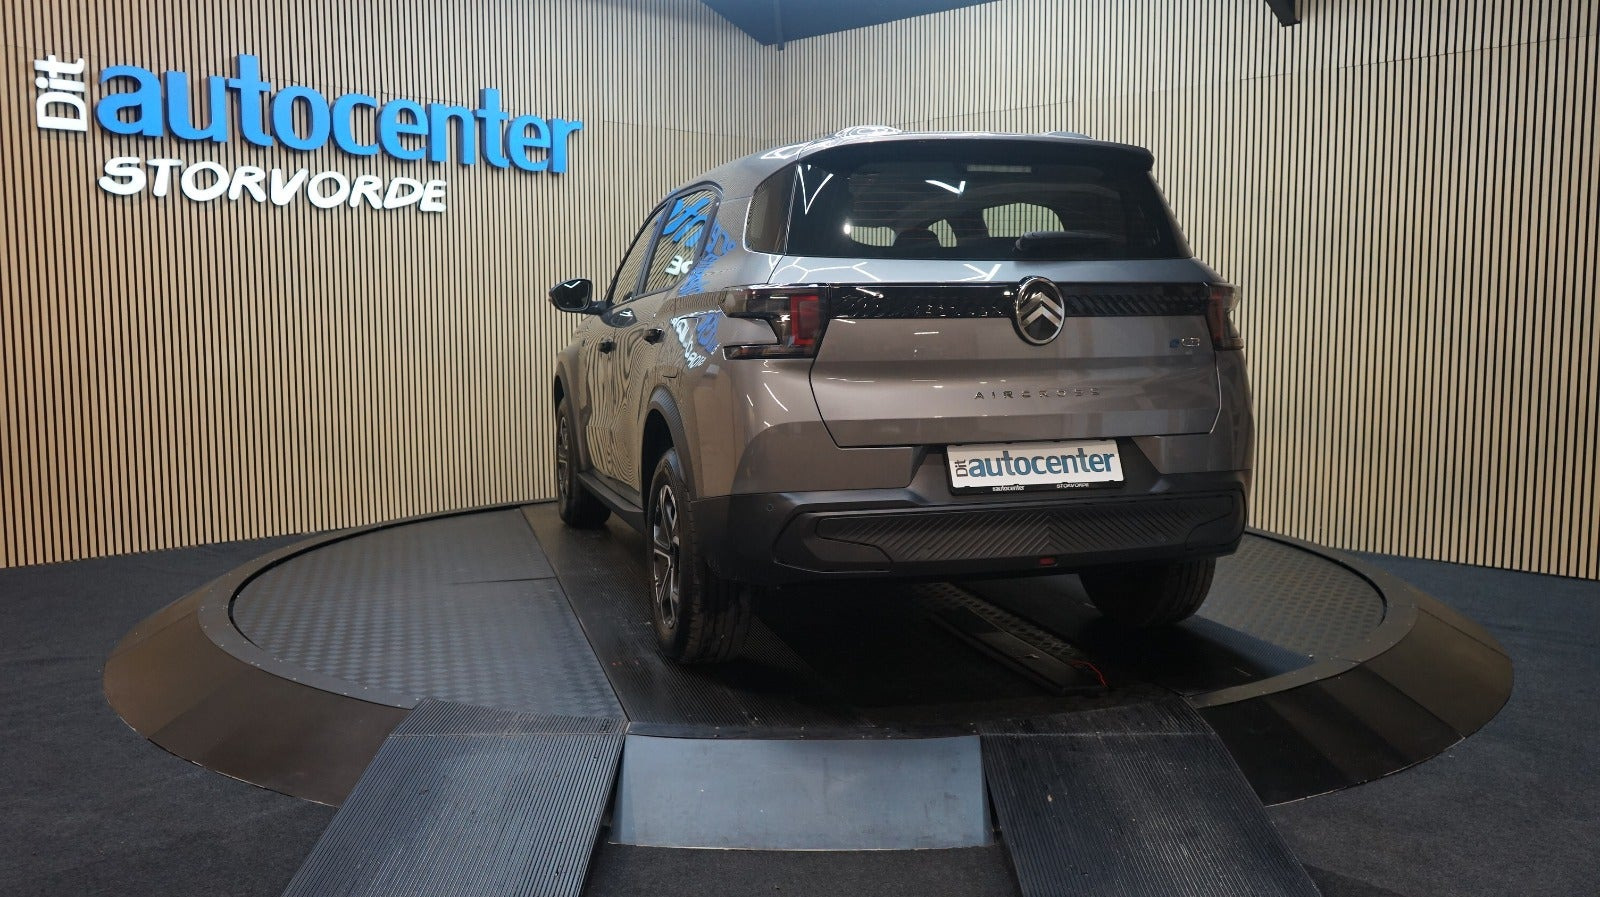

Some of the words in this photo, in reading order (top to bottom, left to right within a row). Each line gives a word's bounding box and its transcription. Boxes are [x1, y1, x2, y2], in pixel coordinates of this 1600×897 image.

[35, 54, 88, 132] Dit
[96, 53, 583, 174] autocenter
[99, 155, 447, 213] STORVORDE
[974, 387, 1100, 399] AIRCROSS
[954, 459, 969, 478] Dit
[968, 447, 1115, 478] autocenter
